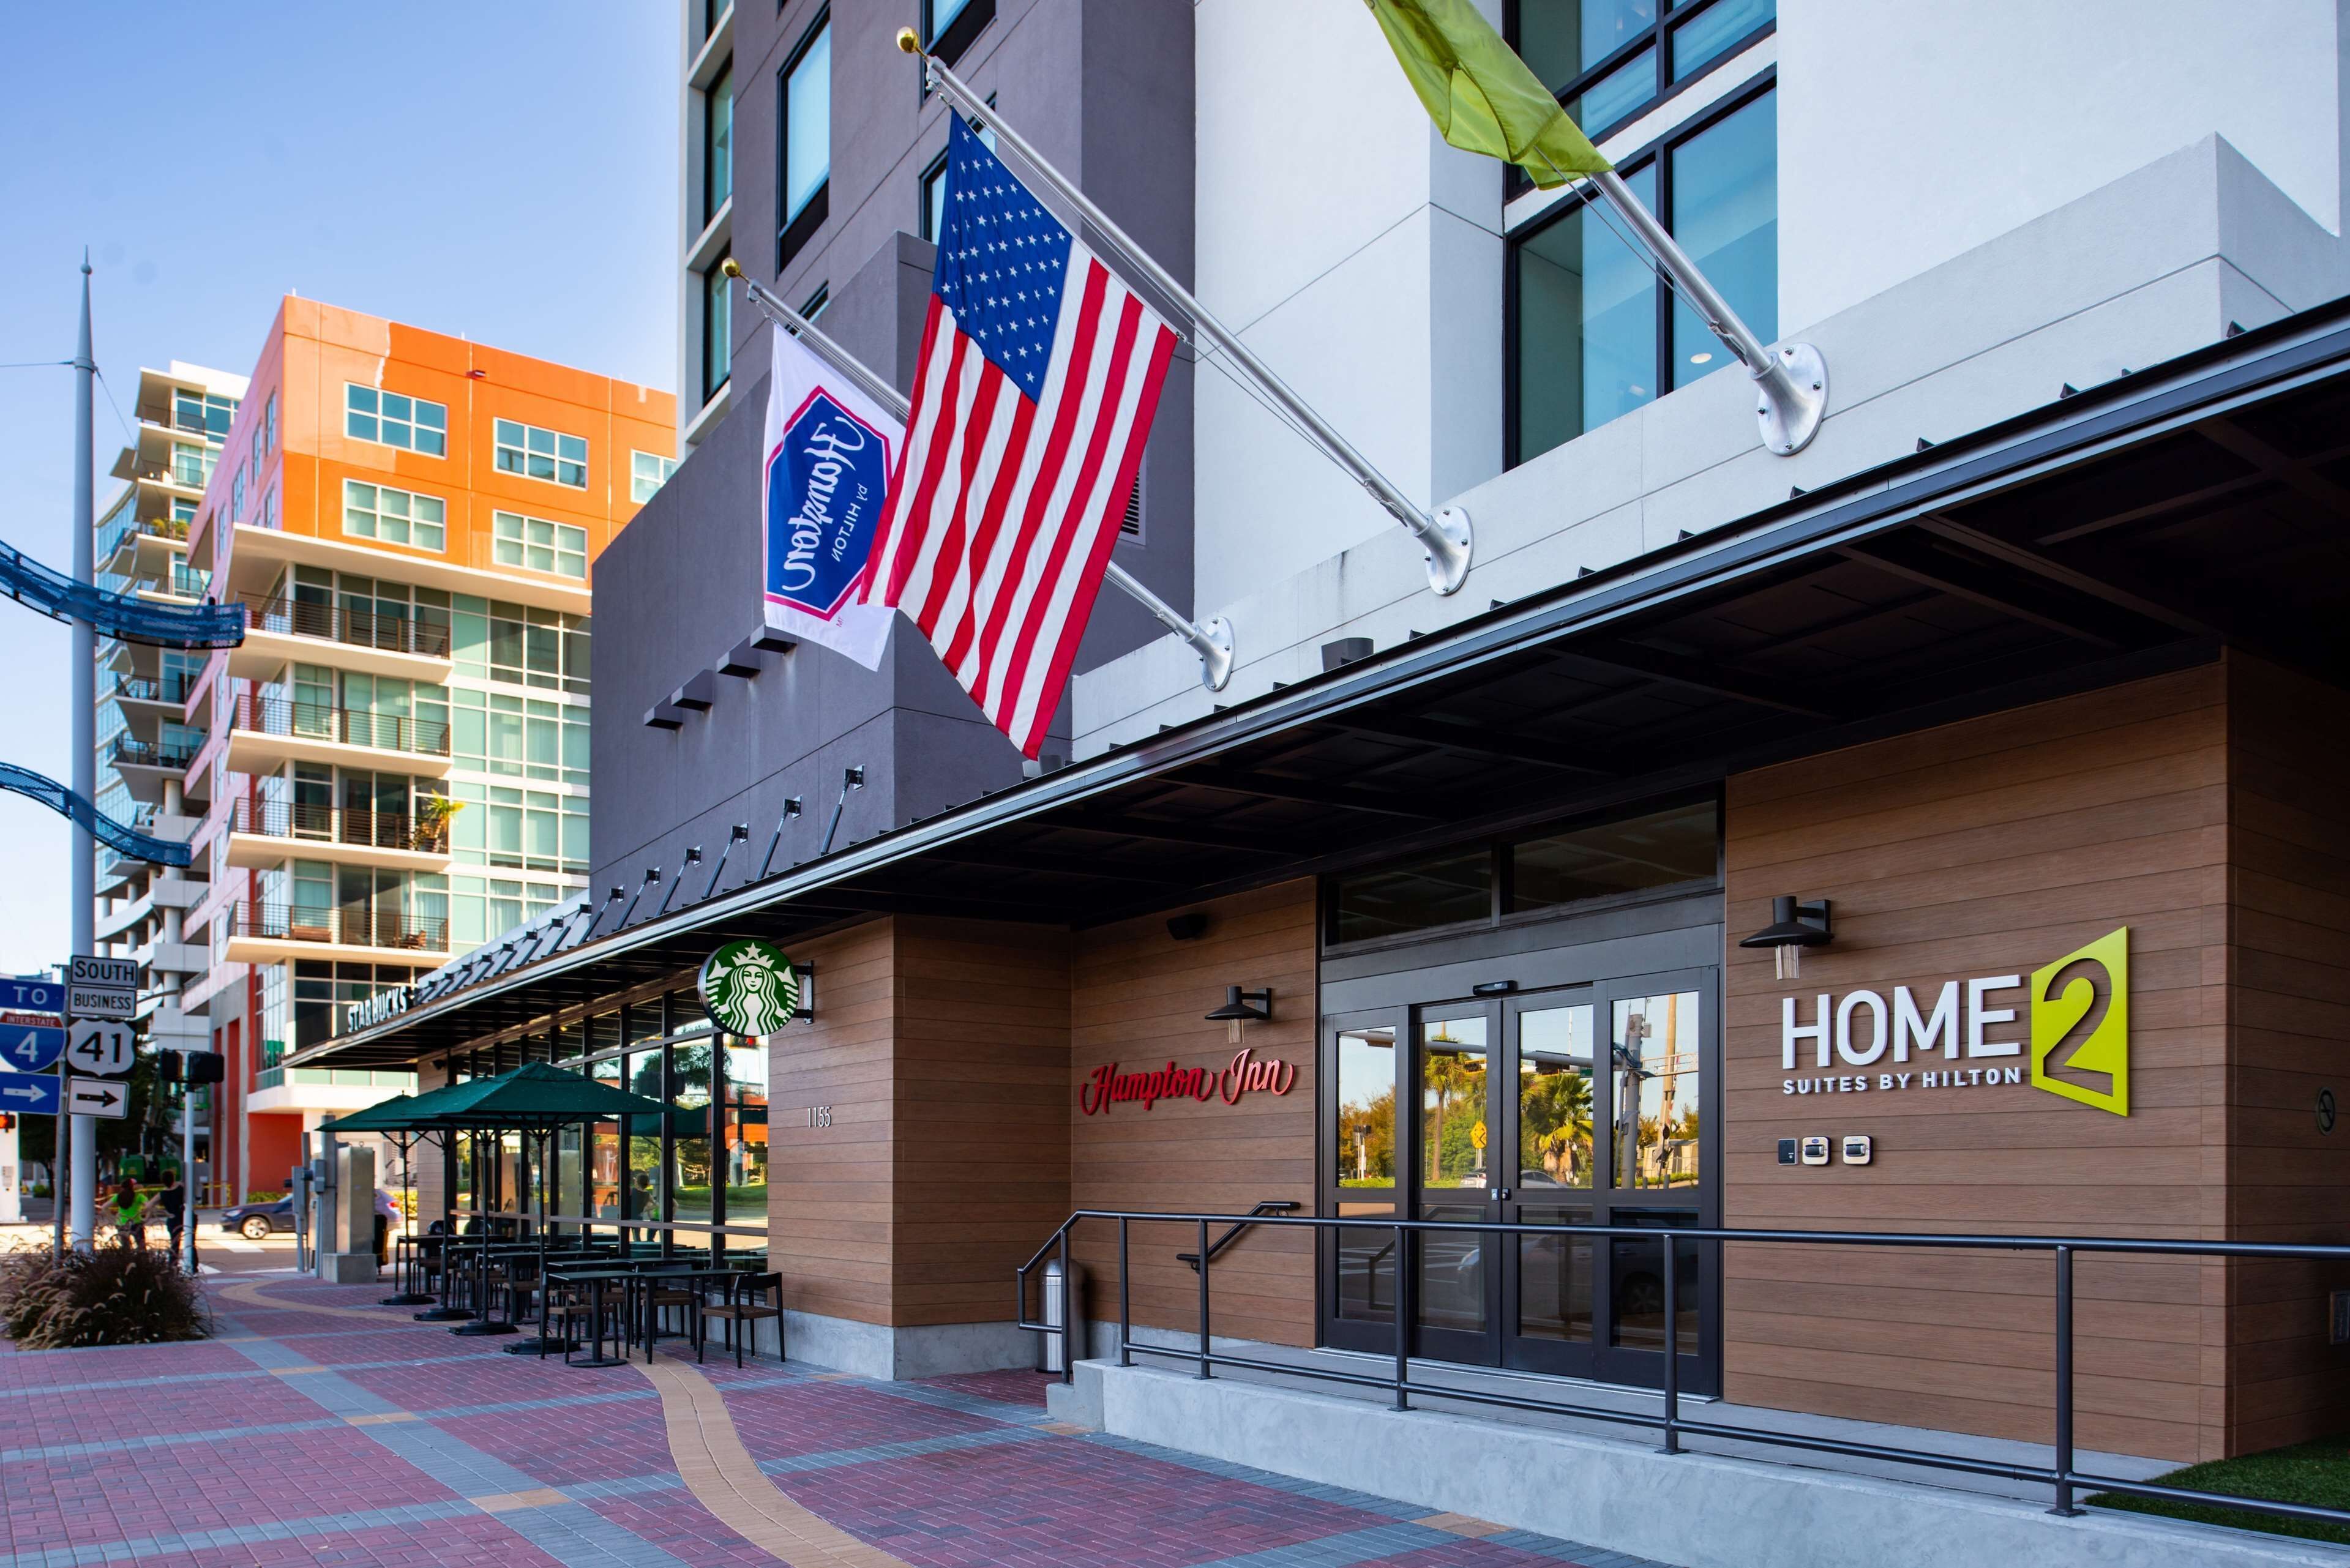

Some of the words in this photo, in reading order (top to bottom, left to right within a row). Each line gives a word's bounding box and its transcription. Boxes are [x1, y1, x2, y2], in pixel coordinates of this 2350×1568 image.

[74, 960, 135, 982] SOUTH
[13, 986, 48, 1004] TO
[74, 993, 132, 1010] BUSINESS
[348, 985, 408, 1033] STARBUCKS
[6, 1015, 56, 1027] INTERSTATE
[1783, 974, 2021, 1069] HOME
[2043, 958, 2114, 1097] 2
[15, 1031, 38, 1062] 4
[76, 1031, 121, 1063] 41
[1079, 1061, 1216, 1116] Hampton
[1219, 1047, 1295, 1106] Inn
[1783, 1075, 1868, 1095] SUITES
[1879, 1072, 1911, 1090] BY
[1922, 1066, 2021, 1088] HILTON
[807, 1106, 831, 1128] 1155
